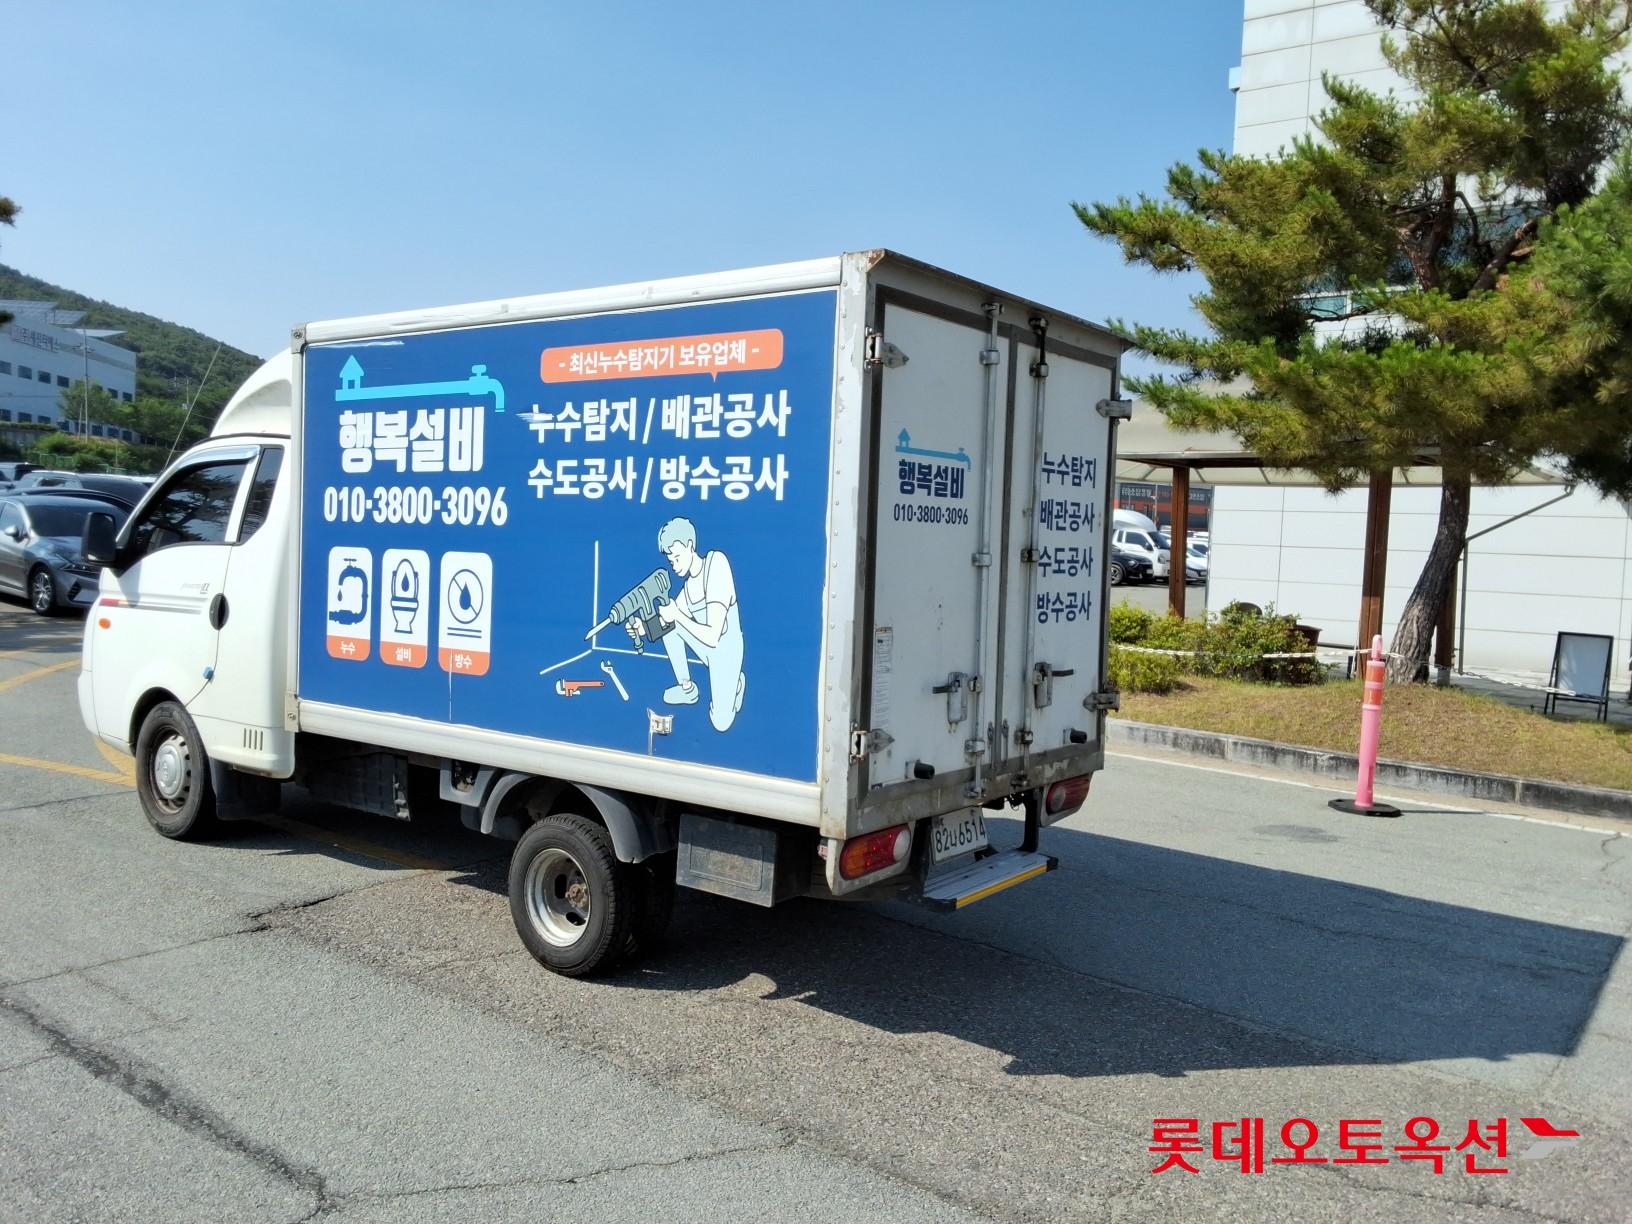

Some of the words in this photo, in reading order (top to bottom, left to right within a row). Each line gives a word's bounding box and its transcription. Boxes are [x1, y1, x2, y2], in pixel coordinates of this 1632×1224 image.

[569, 344, 675, 375] 최신누수탐지기
[679, 338, 747, 367] 보유업체
[529, 397, 638, 443] 누수탐지
[661, 389, 792, 440] 배관공사
[339, 406, 485, 473] 행복설비
[527, 456, 638, 501] 수도공사
[659, 453, 790, 501] 방수공사
[898, 458, 965, 499] 행복설비
[1041, 451, 1097, 489] 누수탐지
[1040, 498, 1095, 533] 배관공사
[1038, 546, 1093, 577] 수도공사
[1036, 590, 1092, 624] 방수공사
[340, 641, 356, 655] 누수
[395, 647, 412, 662] 설비
[454, 653, 473, 669] 방수
[935, 816, 986, 853] 82나6514
